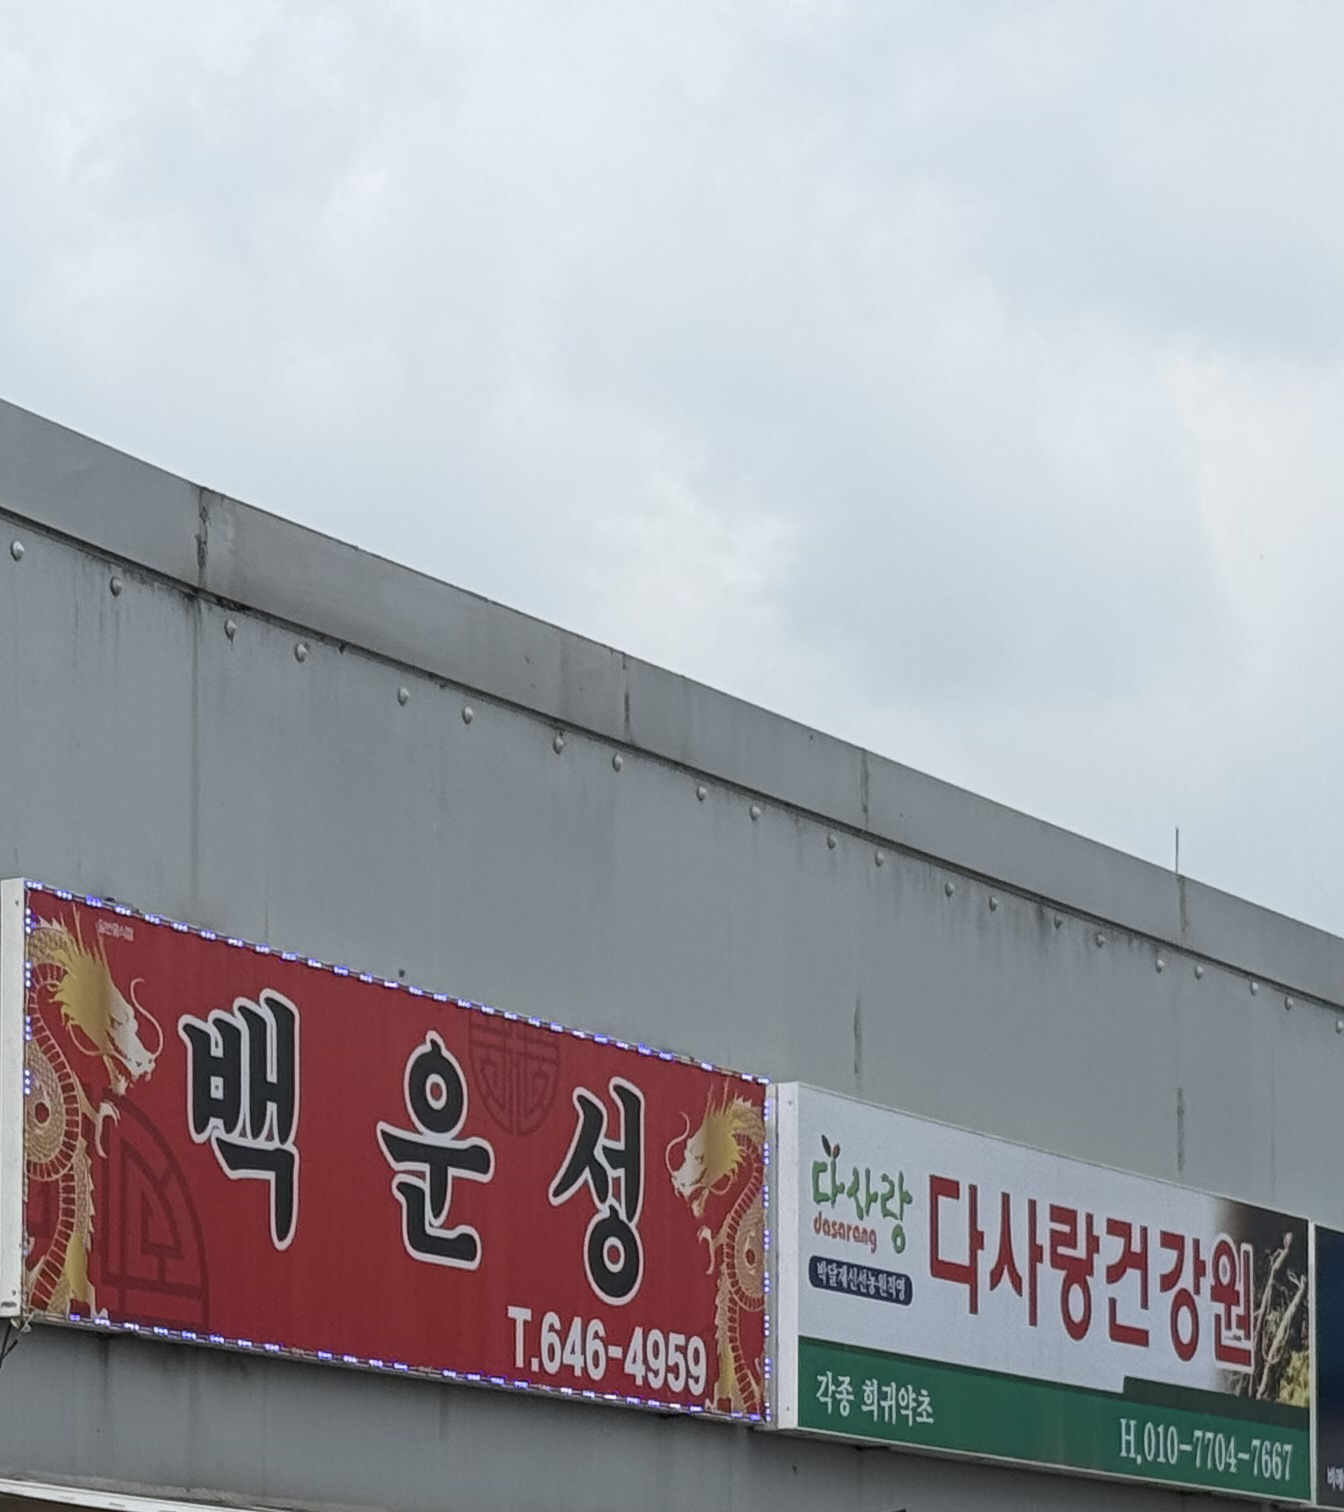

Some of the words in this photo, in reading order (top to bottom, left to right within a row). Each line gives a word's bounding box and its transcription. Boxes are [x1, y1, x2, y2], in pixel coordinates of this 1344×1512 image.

[928, 1174, 1254, 1374] 다사랑건강원
[507, 1306, 707, 1394] T.646-4959
[816, 1371, 855, 1414] 각종
[861, 1380, 934, 1426] 희귀약초
[1119, 1417, 1294, 1481] H.010-7704-7667
